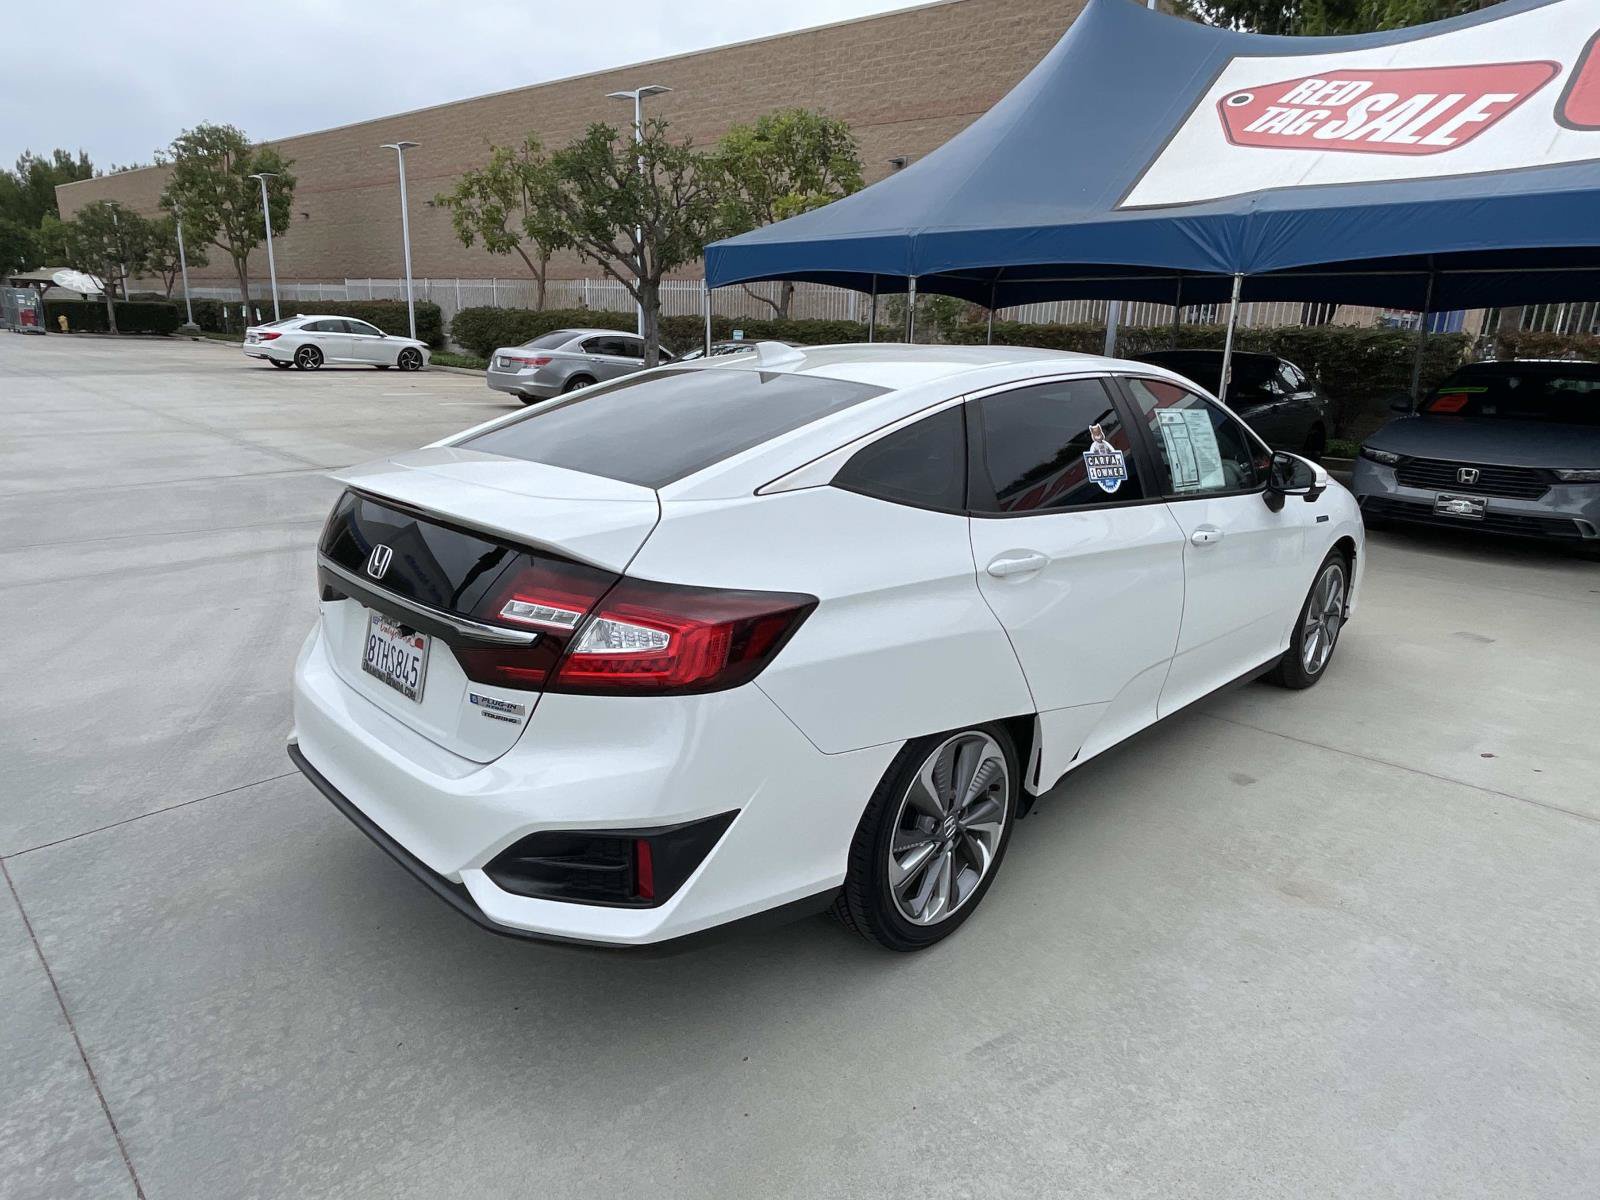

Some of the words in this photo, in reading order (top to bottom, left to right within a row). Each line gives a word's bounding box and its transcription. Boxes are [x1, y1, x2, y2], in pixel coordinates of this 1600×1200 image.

[1277, 78, 1373, 107] RED
[1242, 106, 1325, 136] TAG
[1313, 93, 1518, 146] SALE
[1088, 455, 1121, 466] CARFAX
[1096, 468, 1124, 478] OWNER
[368, 634, 419, 687] 8THS845
[481, 697, 518, 710] PLUG-IN
[483, 712, 518, 724] TOURING
